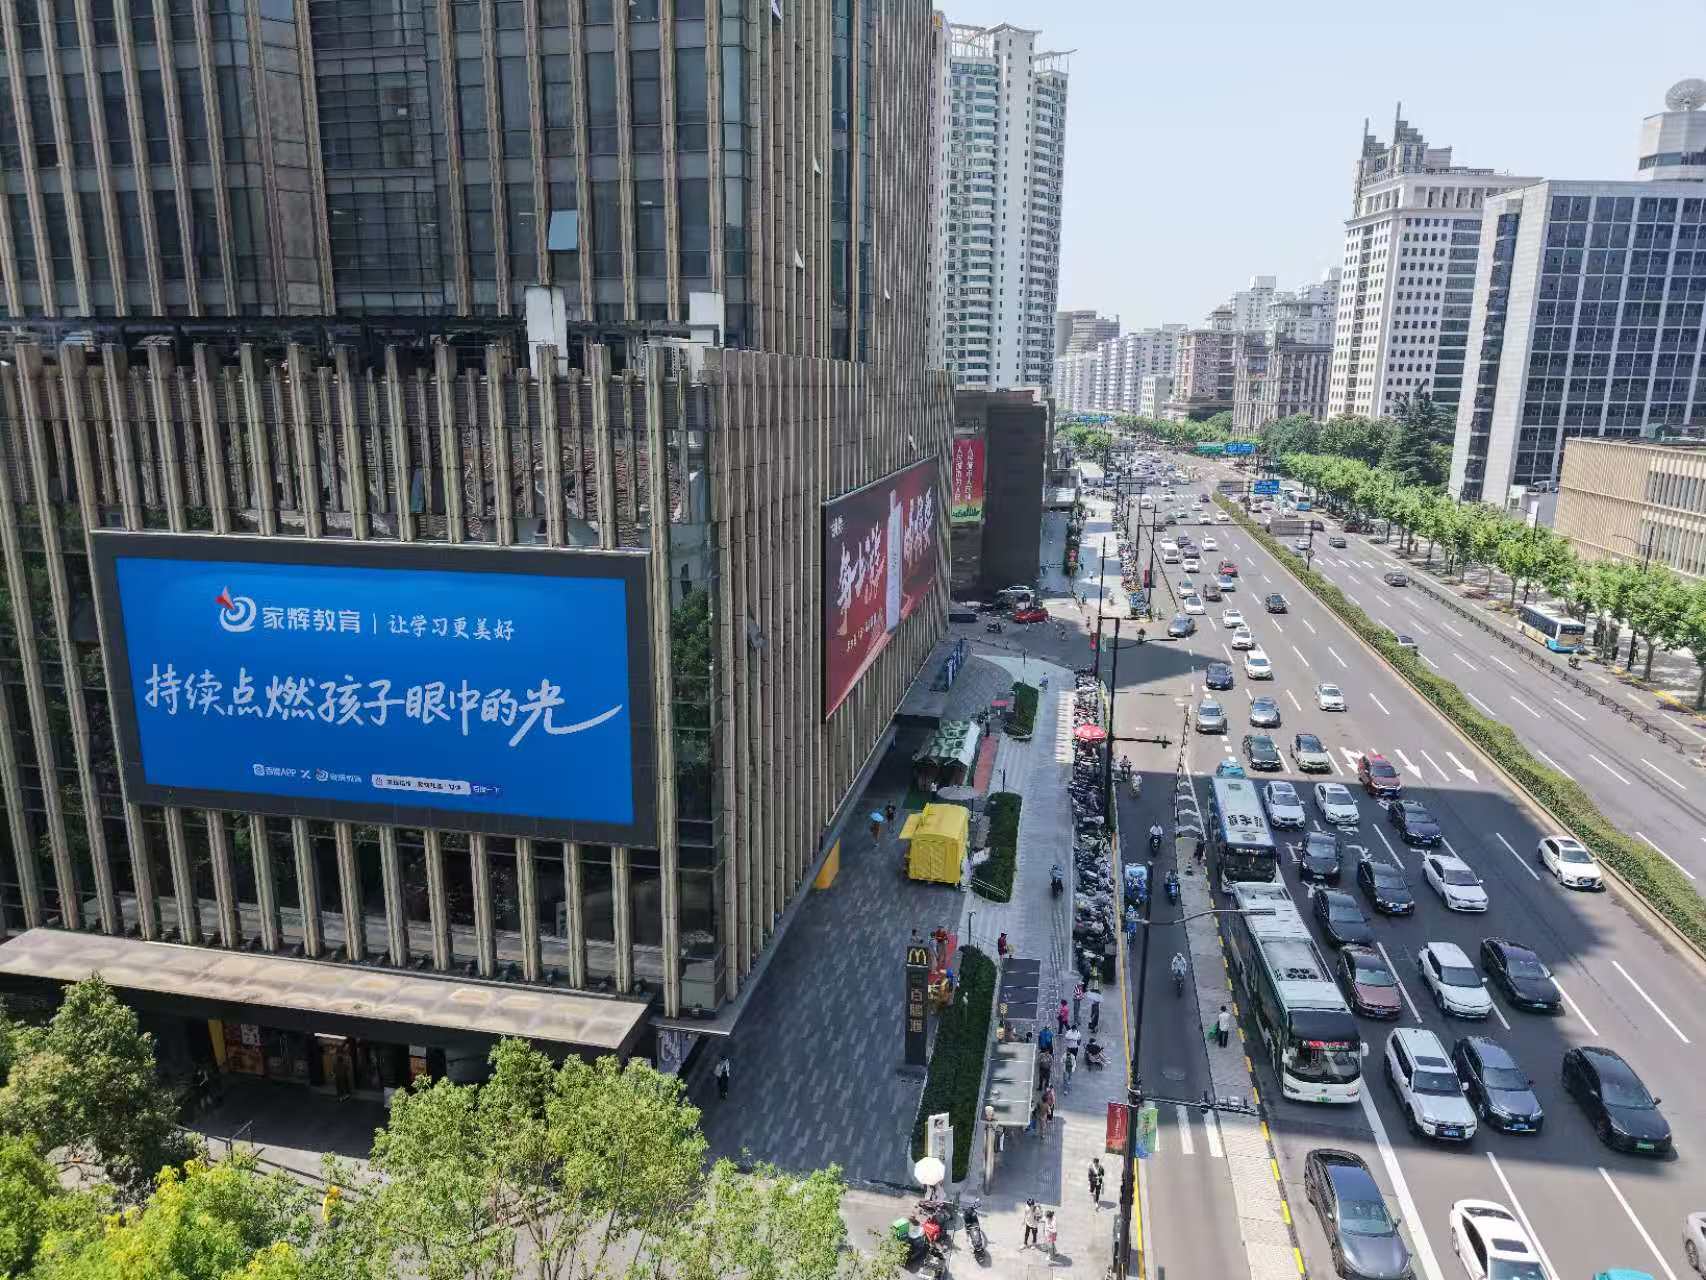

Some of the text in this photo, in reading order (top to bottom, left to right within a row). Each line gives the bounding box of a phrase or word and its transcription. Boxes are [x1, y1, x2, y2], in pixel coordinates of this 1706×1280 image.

[262, 606, 361, 634] 家辉教育
[389, 614, 515, 641] 让学习更美好
[144, 663, 623, 747] 持续点燃孩子眼中的光
